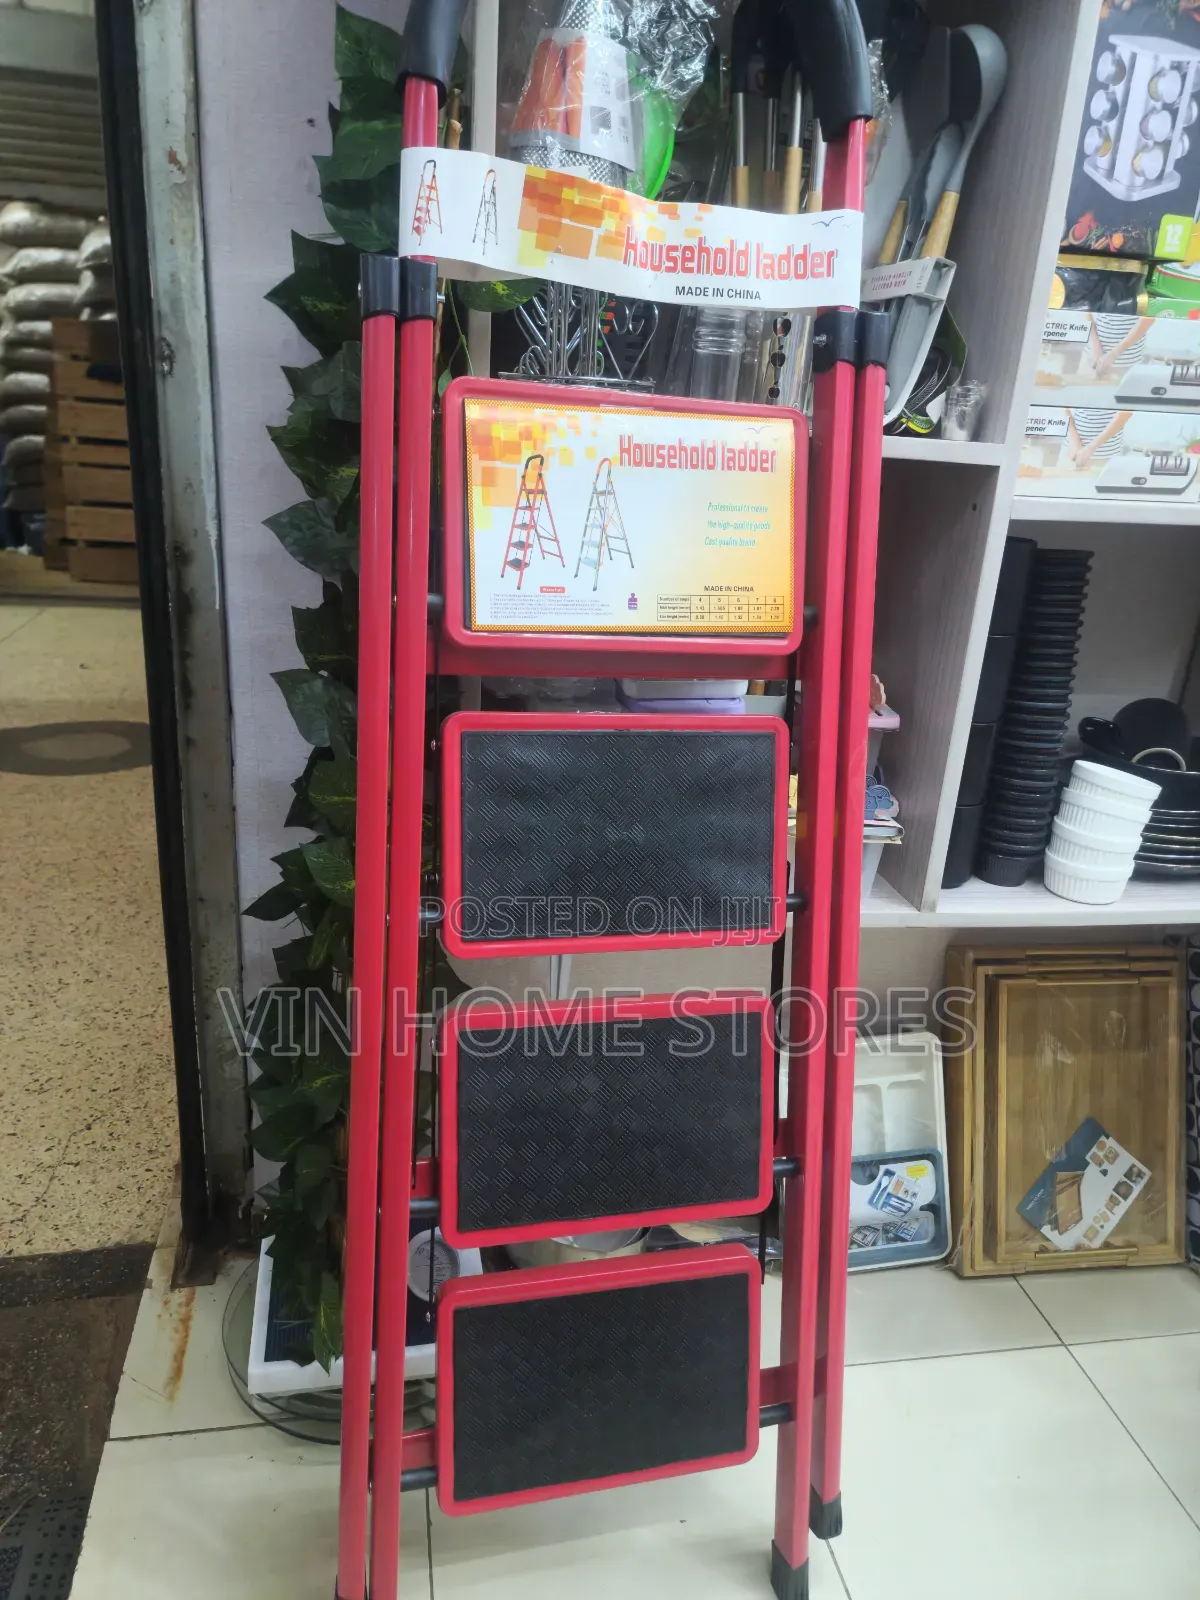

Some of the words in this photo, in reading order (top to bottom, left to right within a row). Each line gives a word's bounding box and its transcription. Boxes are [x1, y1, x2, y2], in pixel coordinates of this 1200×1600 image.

[1165, 223, 1184, 245] 12
[622, 225, 750, 278] Household
[754, 241, 838, 281] ladder
[675, 285, 709, 298] MADE
[712, 287, 724, 298] IN
[727, 288, 762, 300] CHINA
[1045, 322, 1068, 330] CTRIC
[1069, 324, 1088, 332] Knife
[1047, 419, 1066, 427] Knife
[619, 434, 718, 471] Household
[720, 439, 778, 473] ladder
